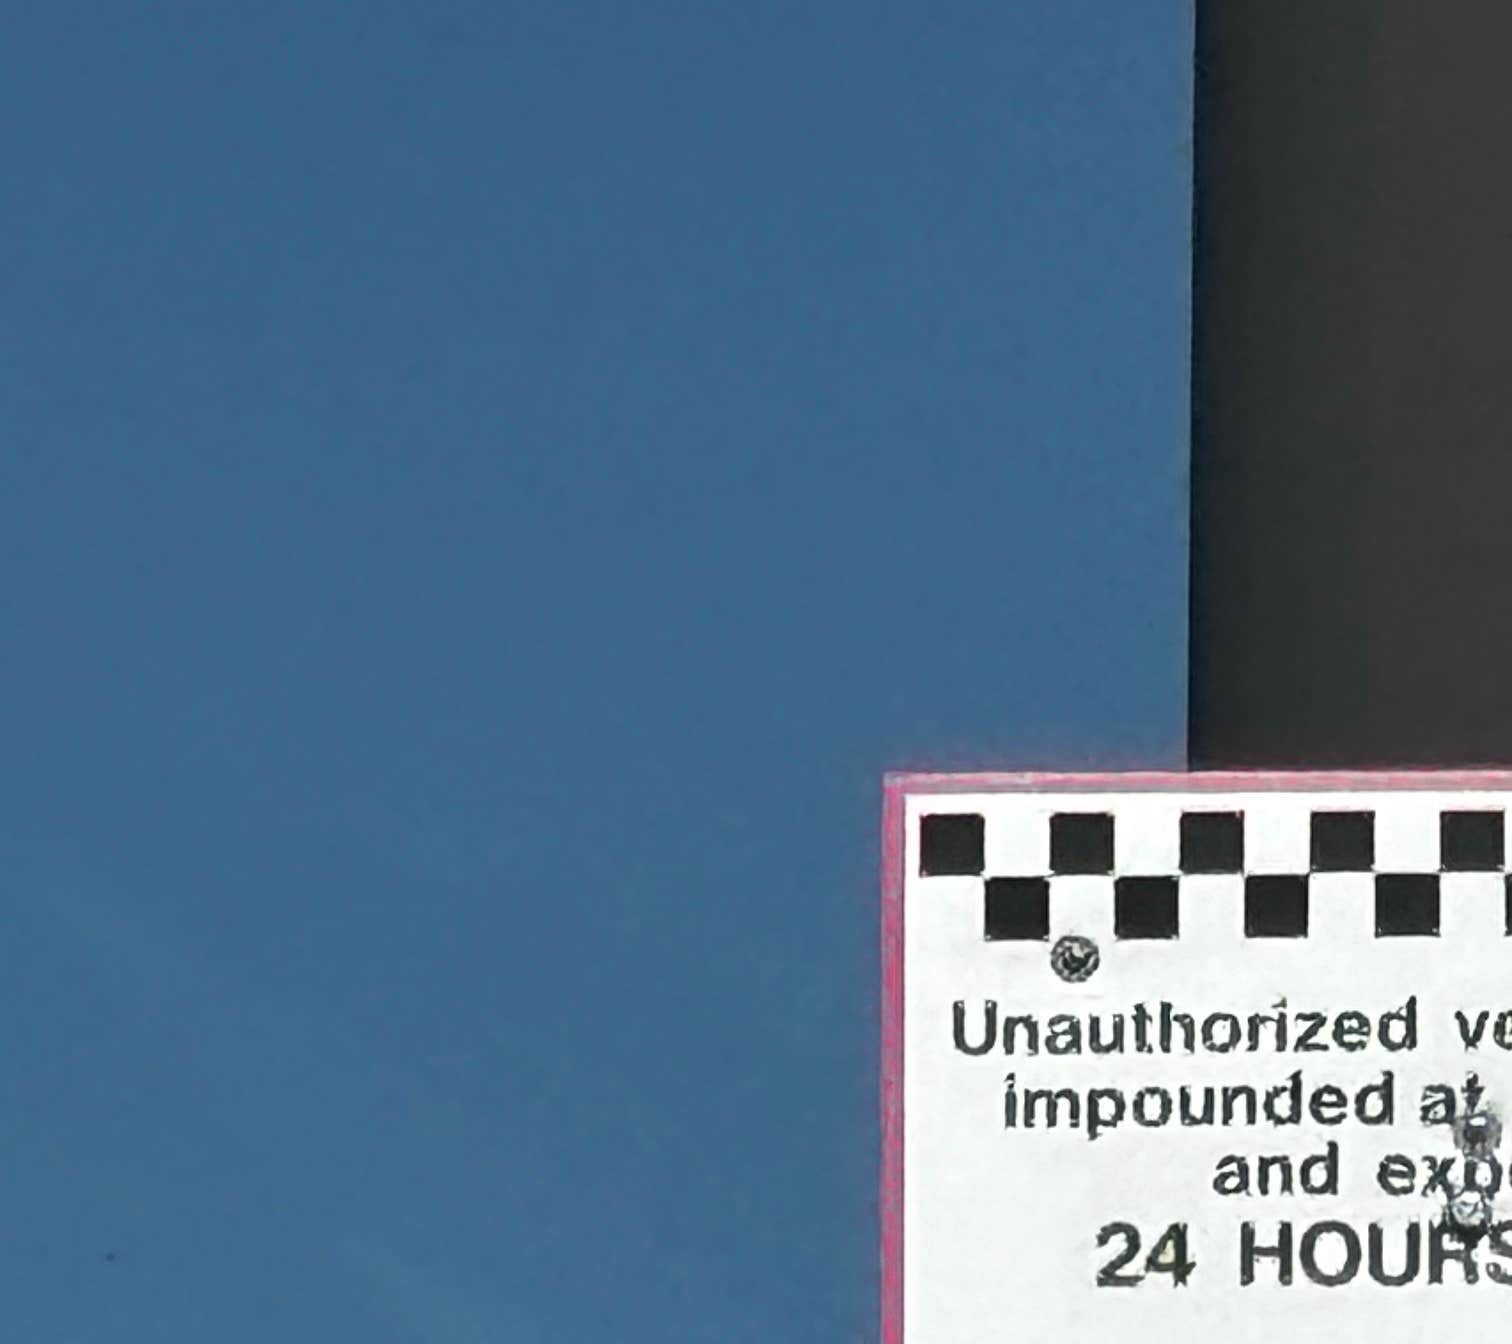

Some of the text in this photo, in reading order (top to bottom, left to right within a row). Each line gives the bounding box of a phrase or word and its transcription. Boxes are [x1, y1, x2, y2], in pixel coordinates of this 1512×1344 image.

[953, 997, 1418, 1054] Unauthorized
[1005, 1069, 1395, 1138] impounded
[1419, 1072, 1486, 1125] at
[1213, 1141, 1339, 1197] and
[1097, 1222, 1197, 1288] 24
